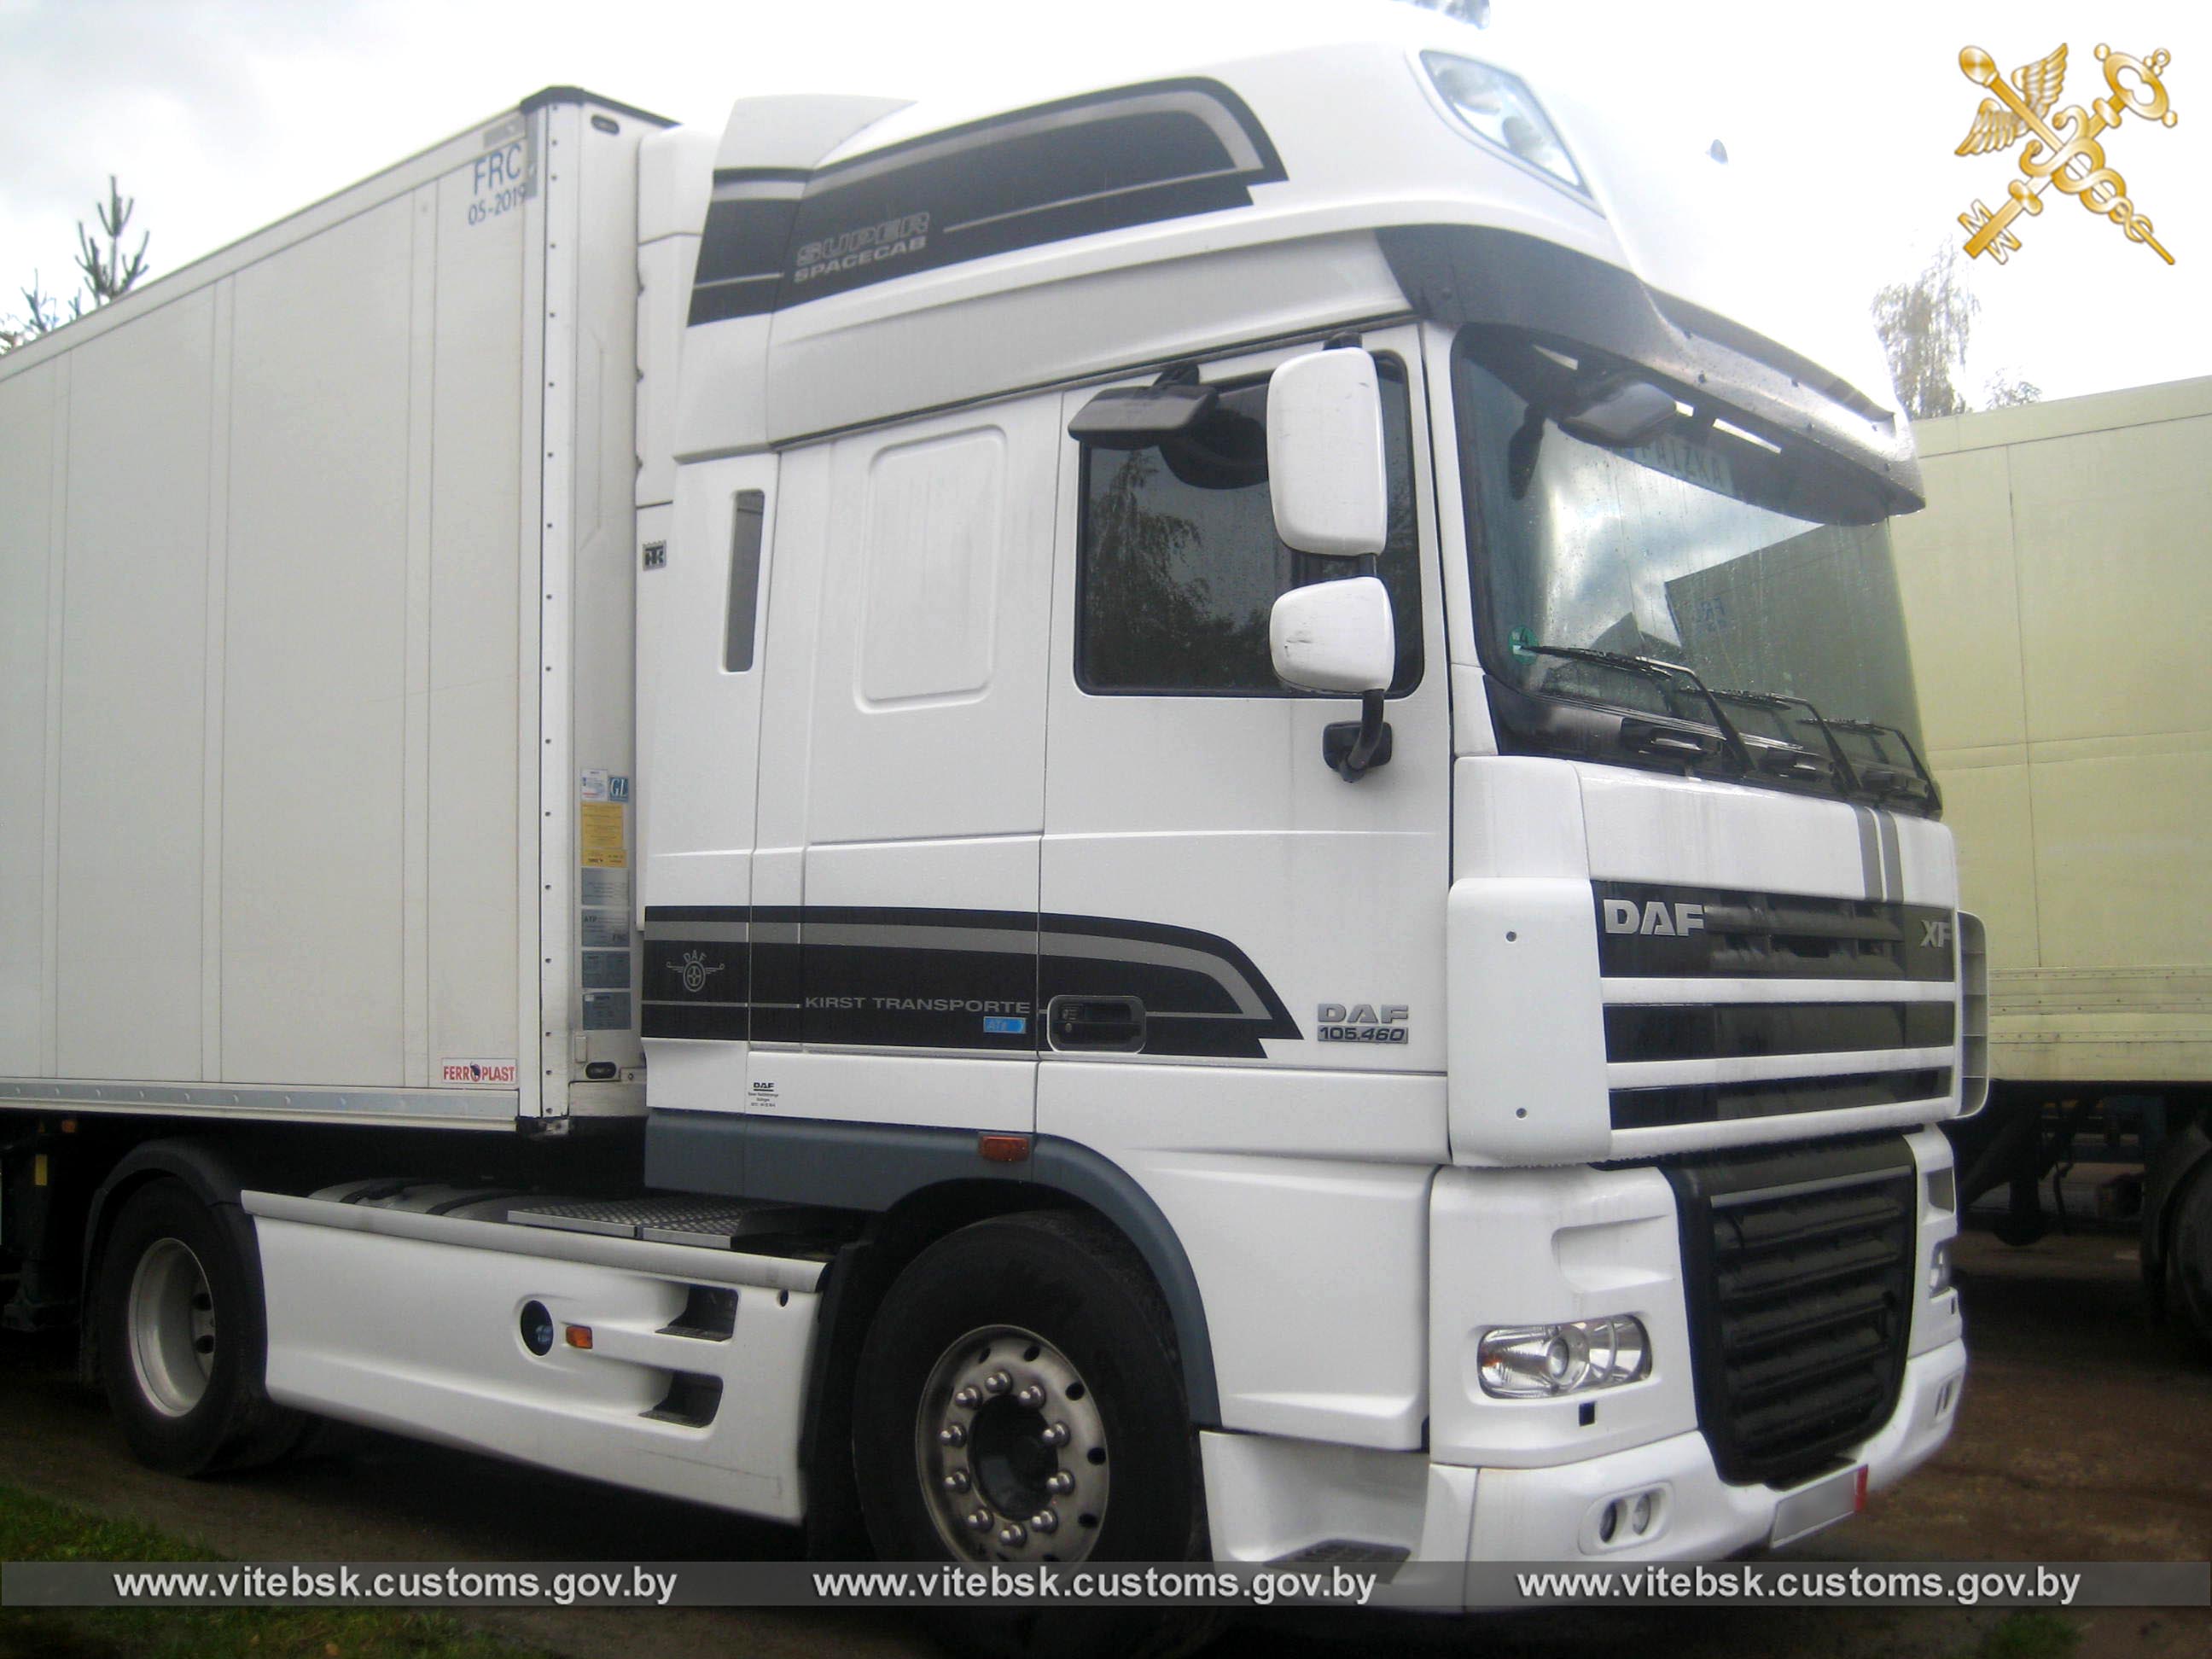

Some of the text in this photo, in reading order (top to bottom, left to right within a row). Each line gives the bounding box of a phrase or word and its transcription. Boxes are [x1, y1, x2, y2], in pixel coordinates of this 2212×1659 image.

[474, 142, 522, 196] FRC
[794, 236, 928, 283] SPACECAB
[1604, 899, 1705, 937] DAF
[1920, 919, 1953, 948] XF
[683, 949, 707, 963] DAF
[806, 997, 1031, 1014] KIRST TRANSPORTE
[1318, 1003, 1408, 1024] DAF
[1319, 1026, 1406, 1042] 105.460
